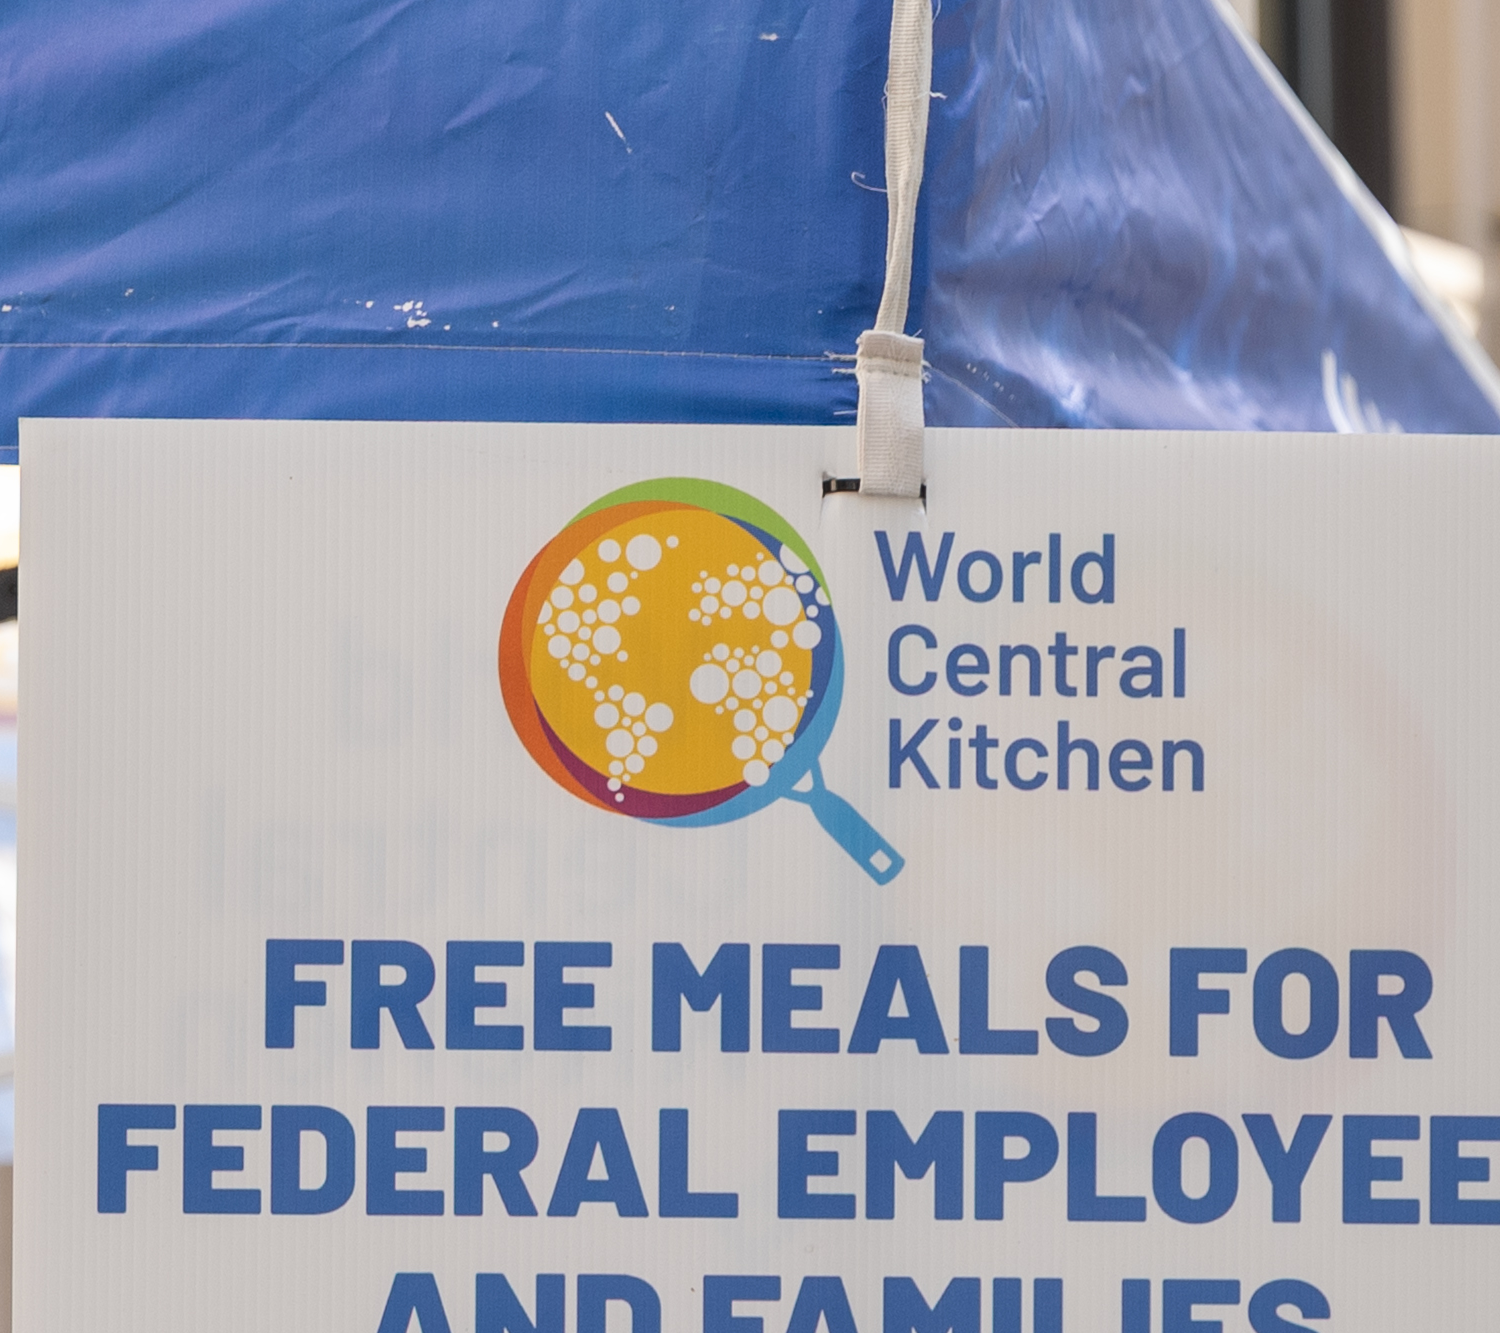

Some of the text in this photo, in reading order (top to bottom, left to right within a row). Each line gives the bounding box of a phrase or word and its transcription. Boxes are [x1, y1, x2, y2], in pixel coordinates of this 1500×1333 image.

[874, 530, 1116, 604] World
[888, 624, 1186, 699] Central
[889, 717, 1205, 792] Kitchen
[264, 938, 613, 1052] FREE
[650, 942, 1129, 1057] MEALS
[1168, 947, 1433, 1060] FOR
[96, 1103, 739, 1219] FEDERAL
